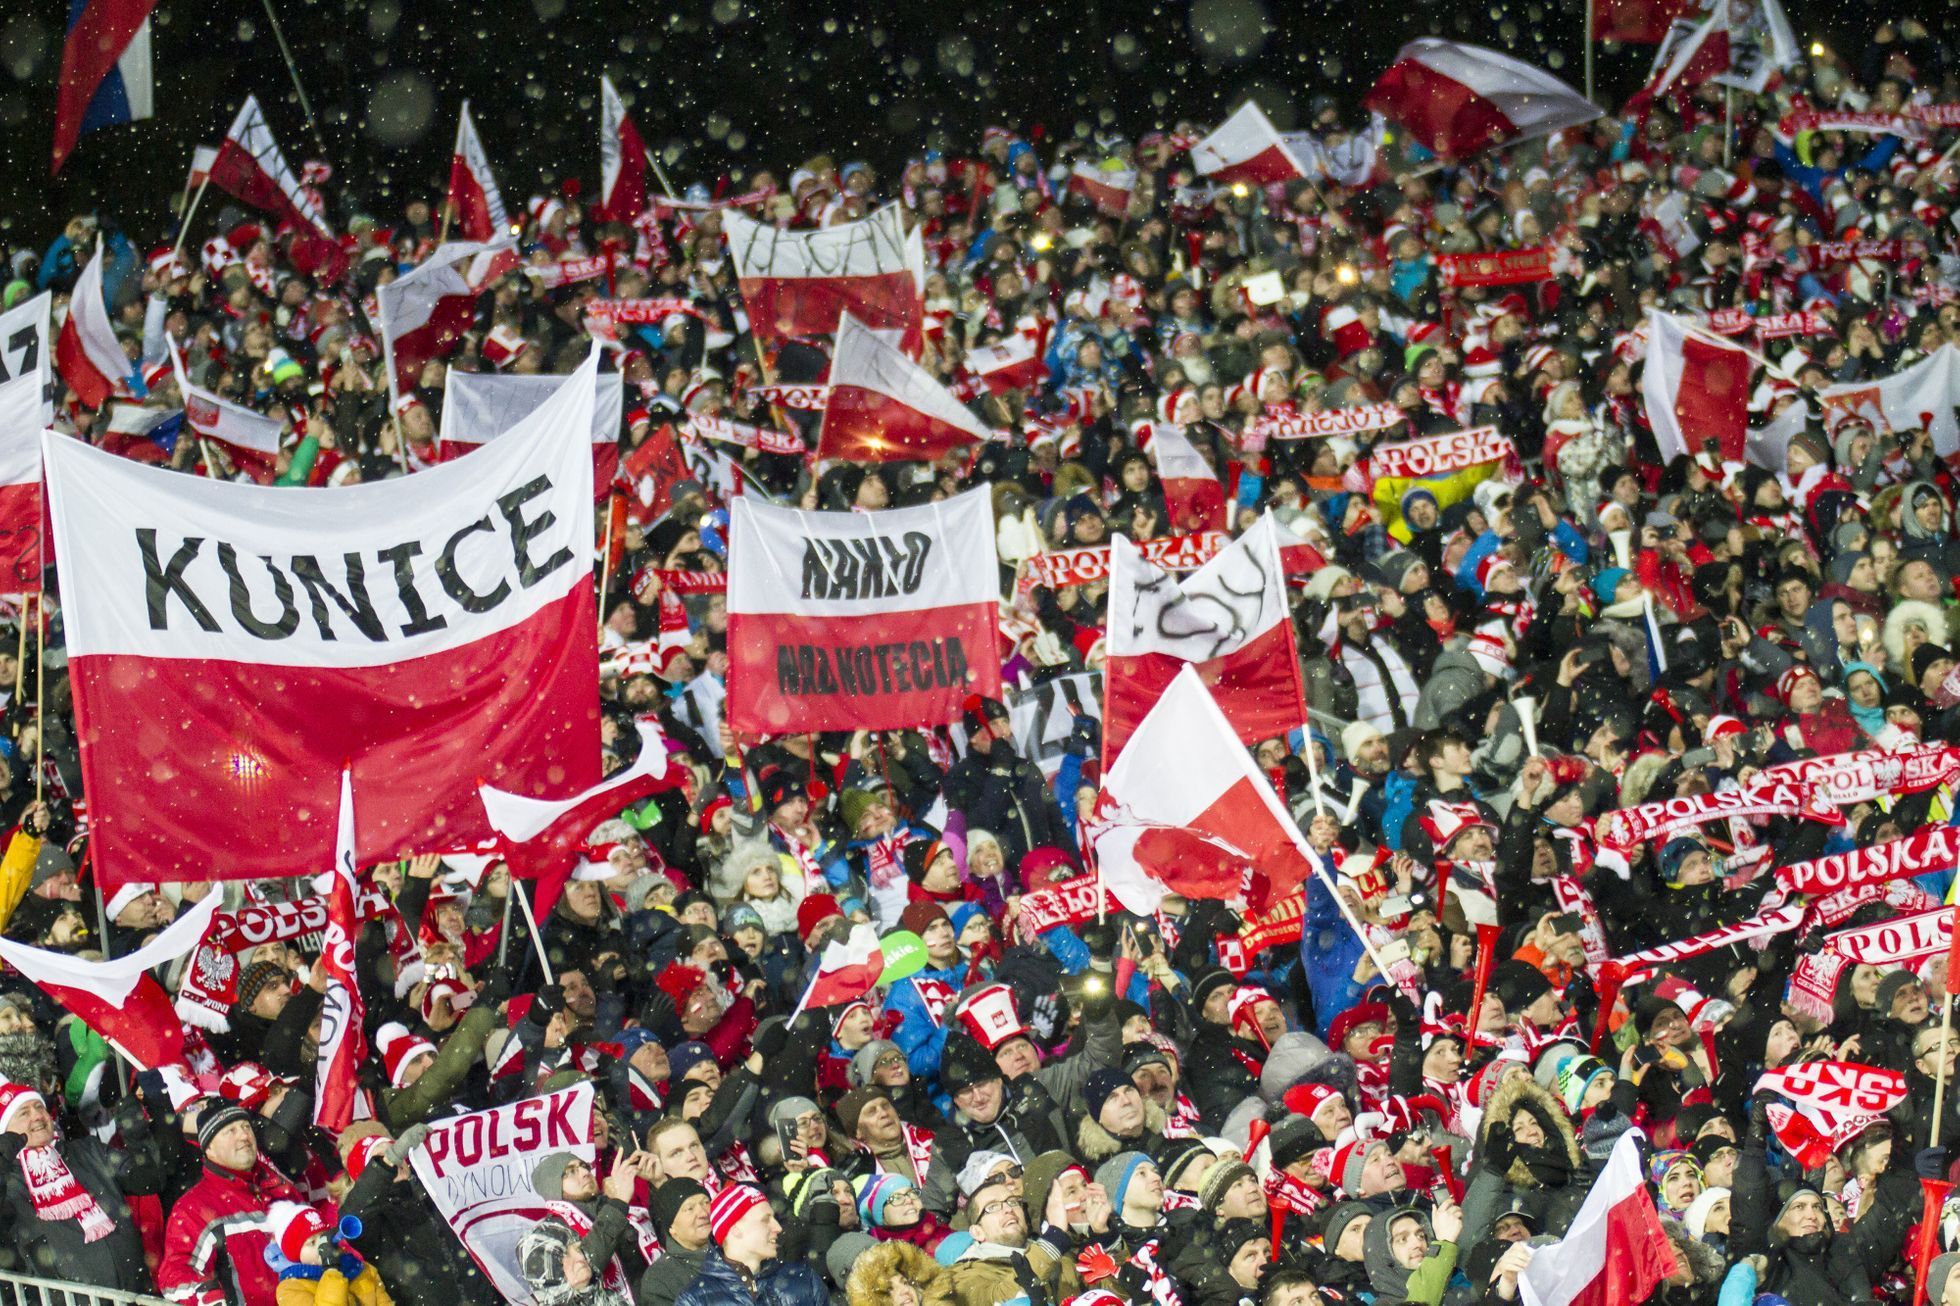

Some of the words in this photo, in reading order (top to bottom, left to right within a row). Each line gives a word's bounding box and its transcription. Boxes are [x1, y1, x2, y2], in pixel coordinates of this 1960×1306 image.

[135, 473, 575, 642] KUNICE
[1639, 783, 1799, 827] POLSKA
[1791, 831, 1953, 889] POLSKA
[216, 886, 390, 943] POLSA
[1844, 913, 1954, 961] POLS
